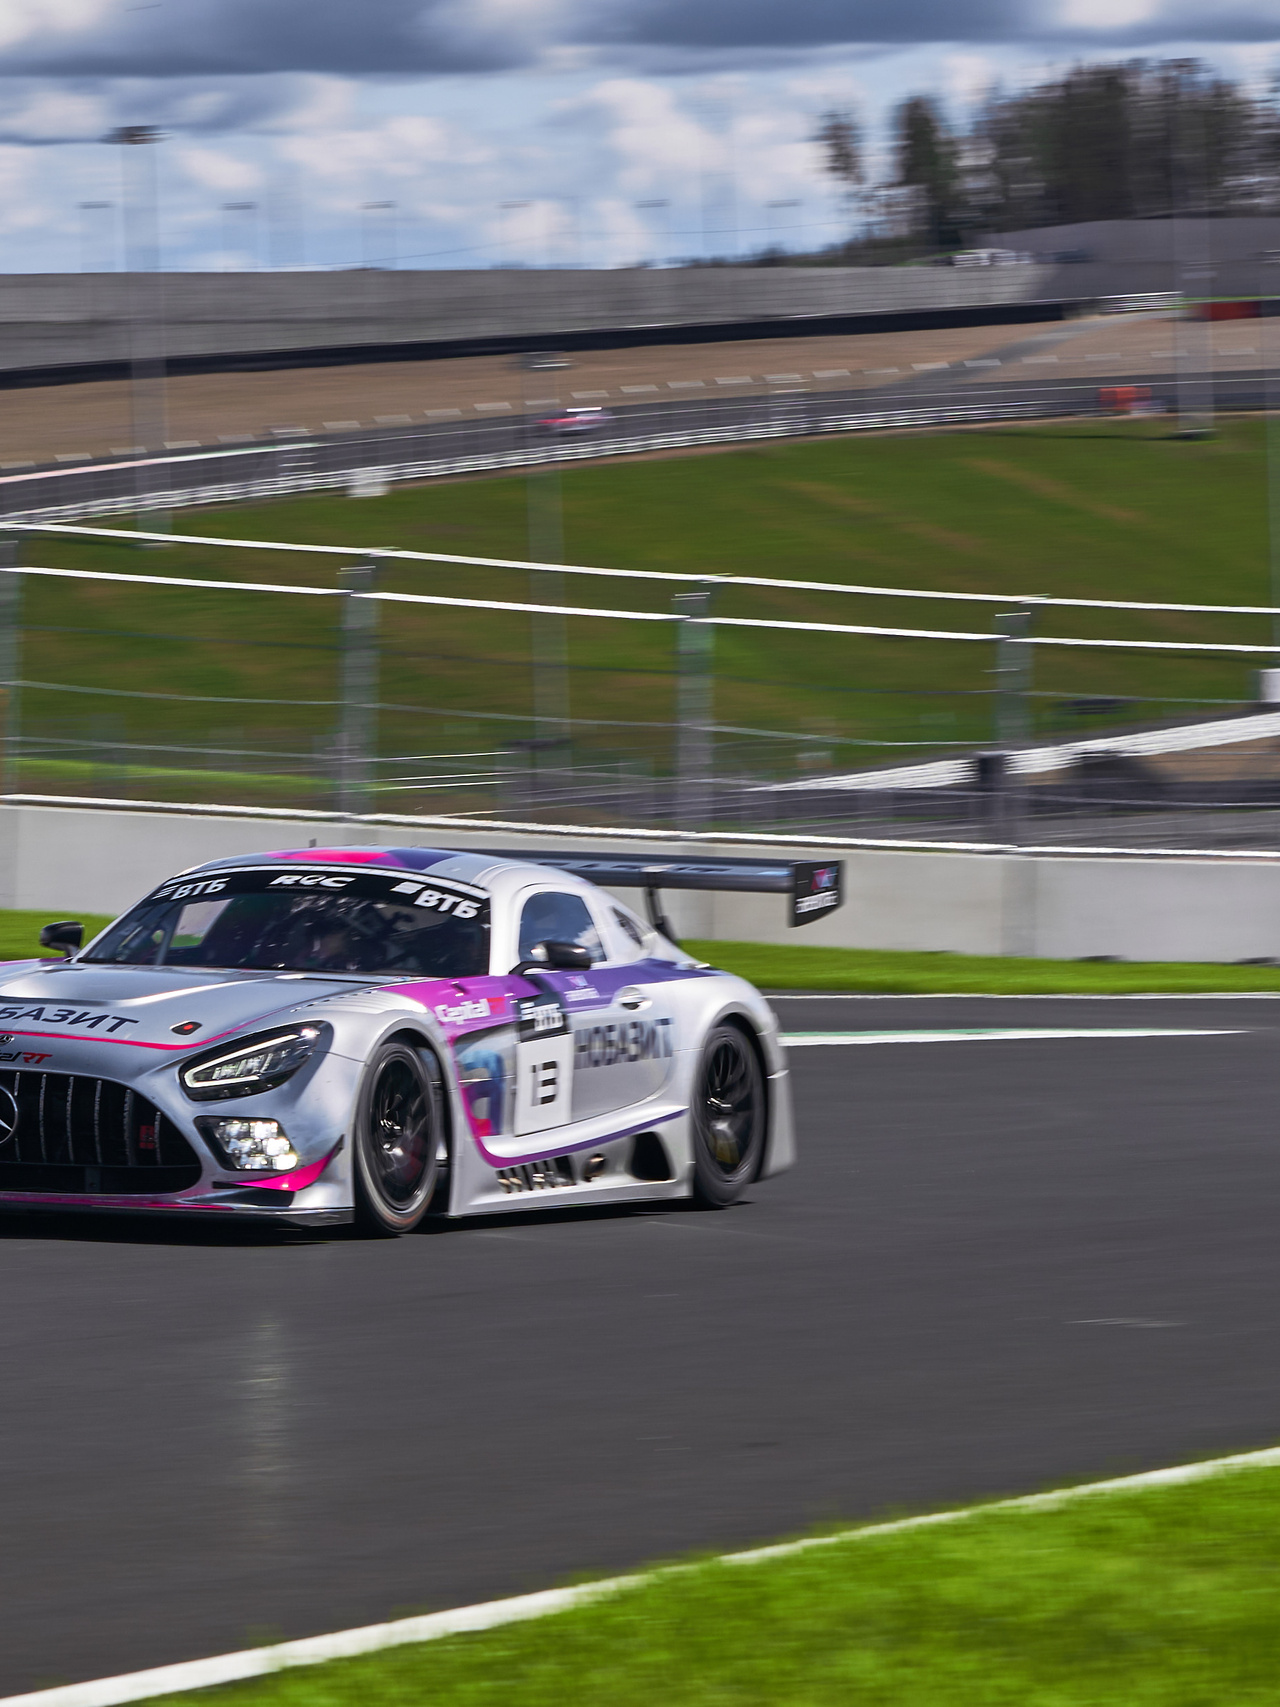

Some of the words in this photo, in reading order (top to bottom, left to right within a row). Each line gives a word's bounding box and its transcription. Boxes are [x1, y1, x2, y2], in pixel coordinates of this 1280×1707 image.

[170, 878, 231, 900] ВТБ
[414, 891, 482, 919] ВТБ
[531, 1061, 558, 1106] 13
